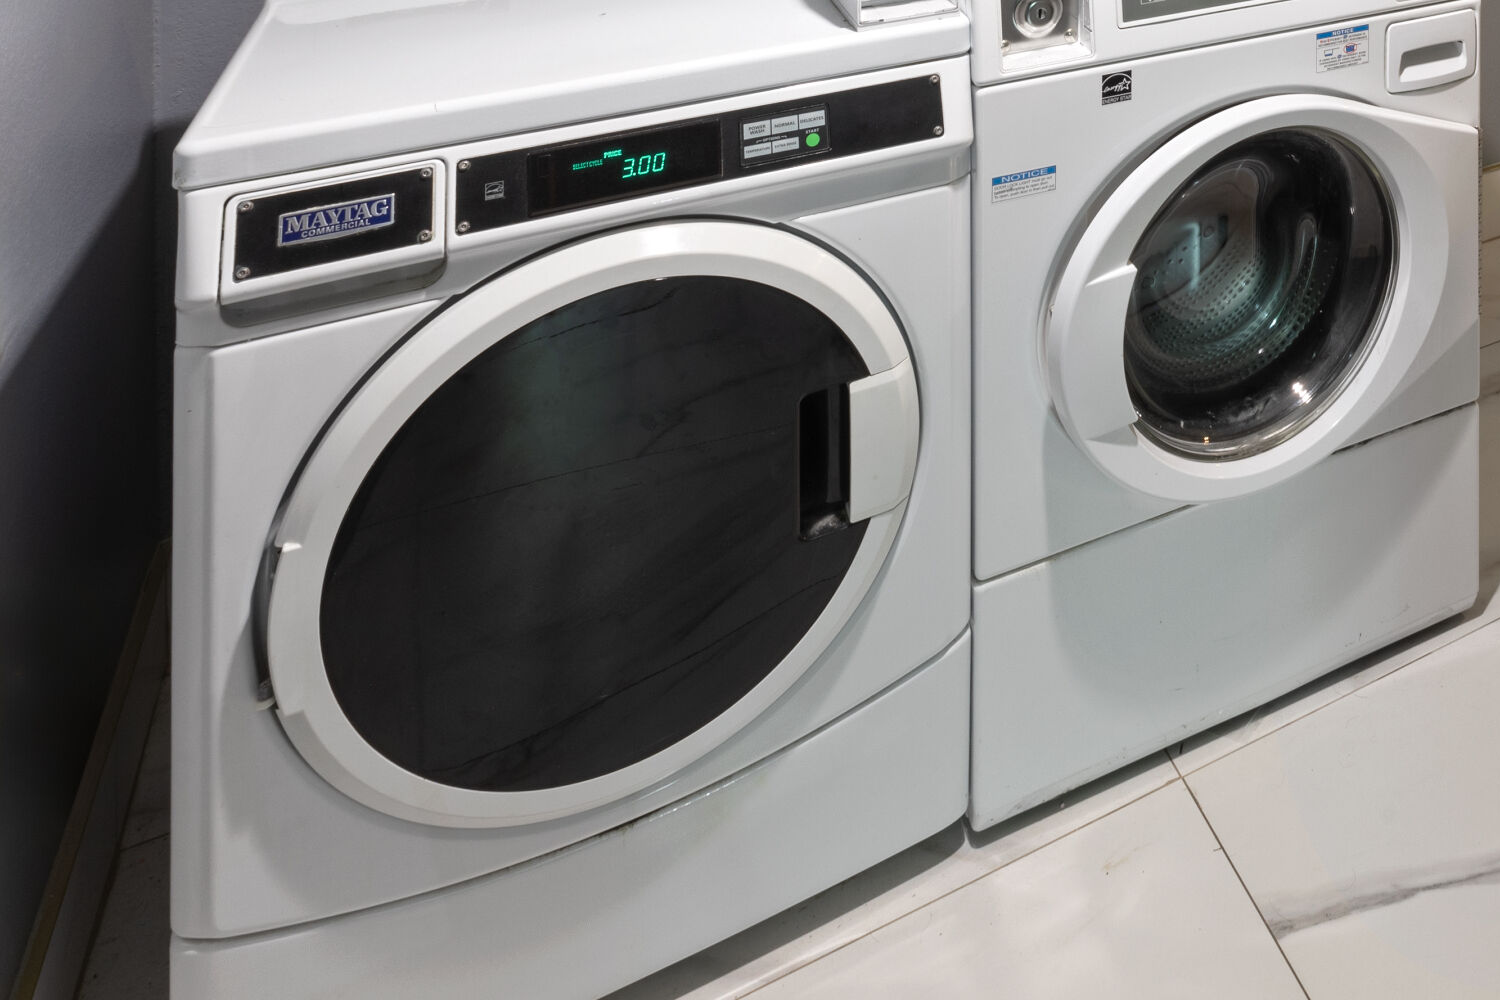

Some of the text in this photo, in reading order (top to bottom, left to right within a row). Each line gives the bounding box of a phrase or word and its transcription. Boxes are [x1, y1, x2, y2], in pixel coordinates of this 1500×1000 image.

[1332, 28, 1353, 36] NOTICE
[622, 152, 665, 179] 3.00
[1001, 168, 1048, 183] NOTICE
[285, 199, 390, 235] MAYTAG
[301, 218, 371, 239] COMMERCIAL
